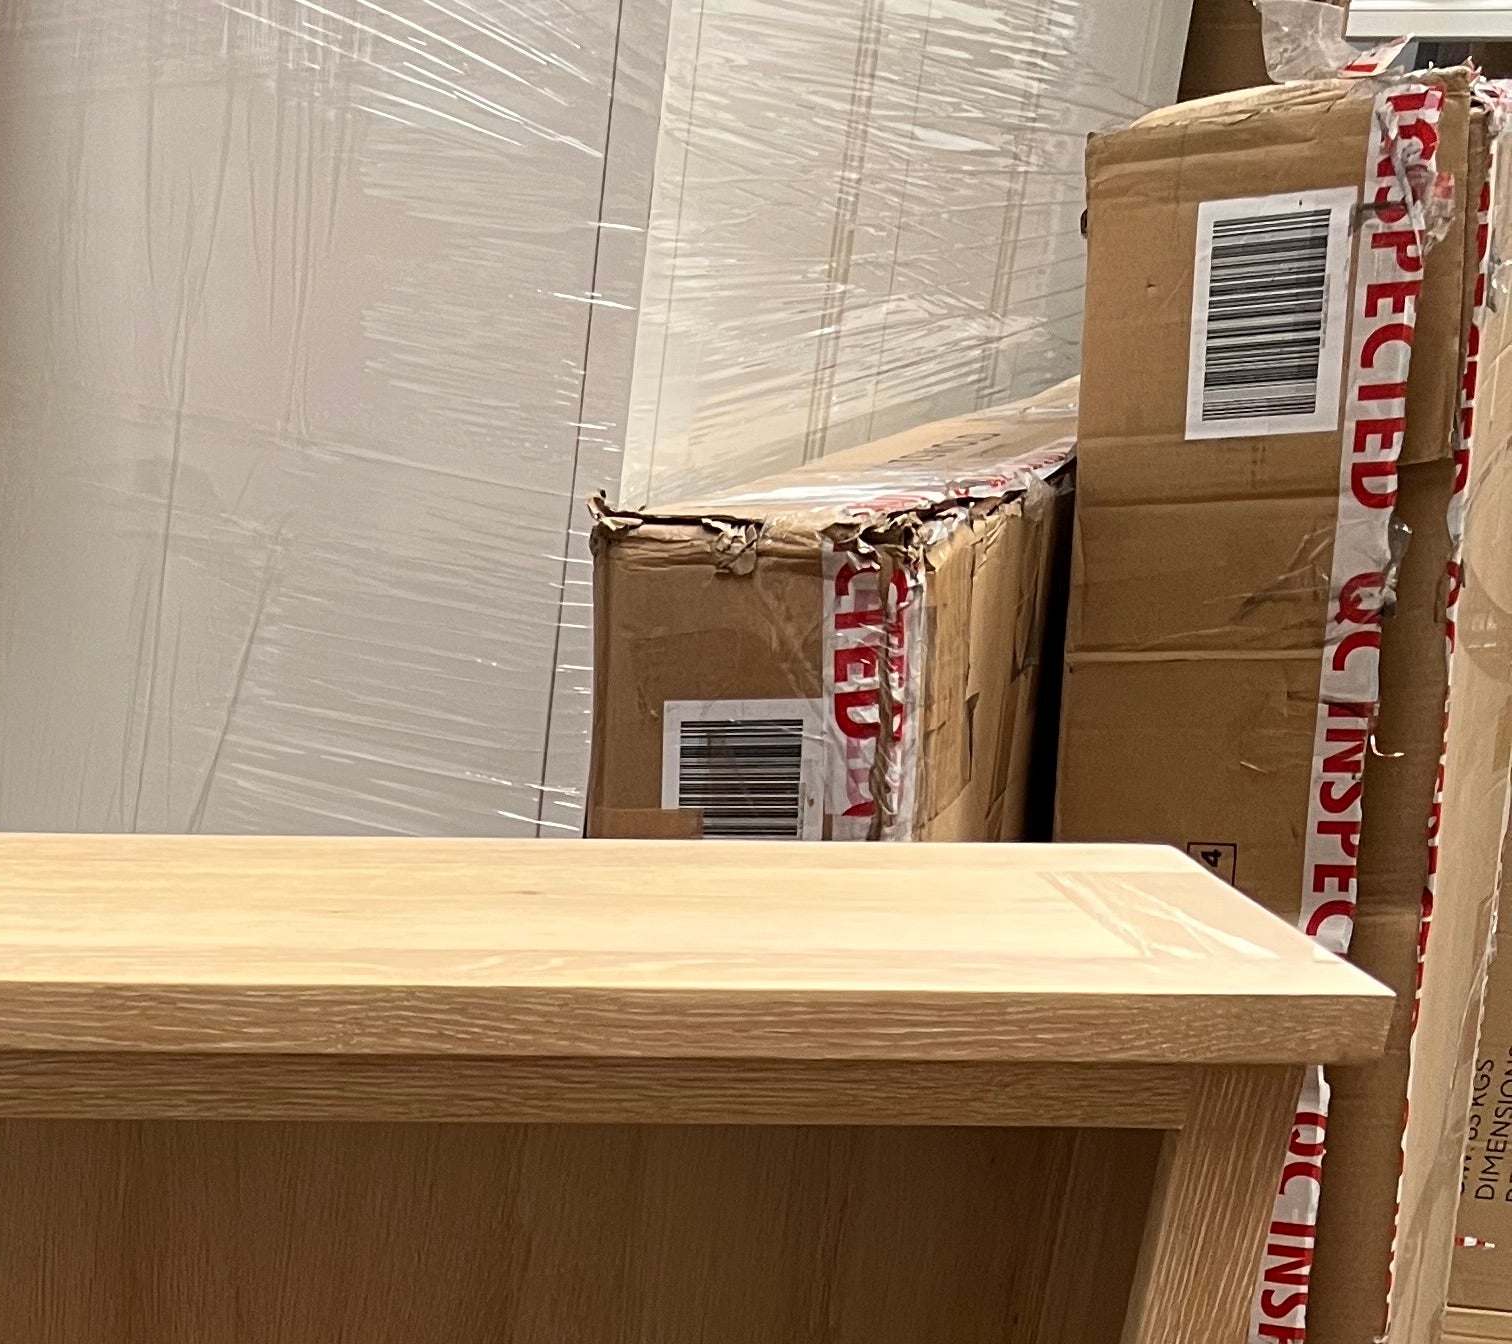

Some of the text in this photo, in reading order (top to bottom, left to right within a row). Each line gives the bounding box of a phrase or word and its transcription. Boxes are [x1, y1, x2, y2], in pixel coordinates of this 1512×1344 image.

[1306, 571, 1389, 937] QC INSPEC
[1200, 849, 1222, 868] 4
[1474, 1046, 1512, 1201] DIMENSION
